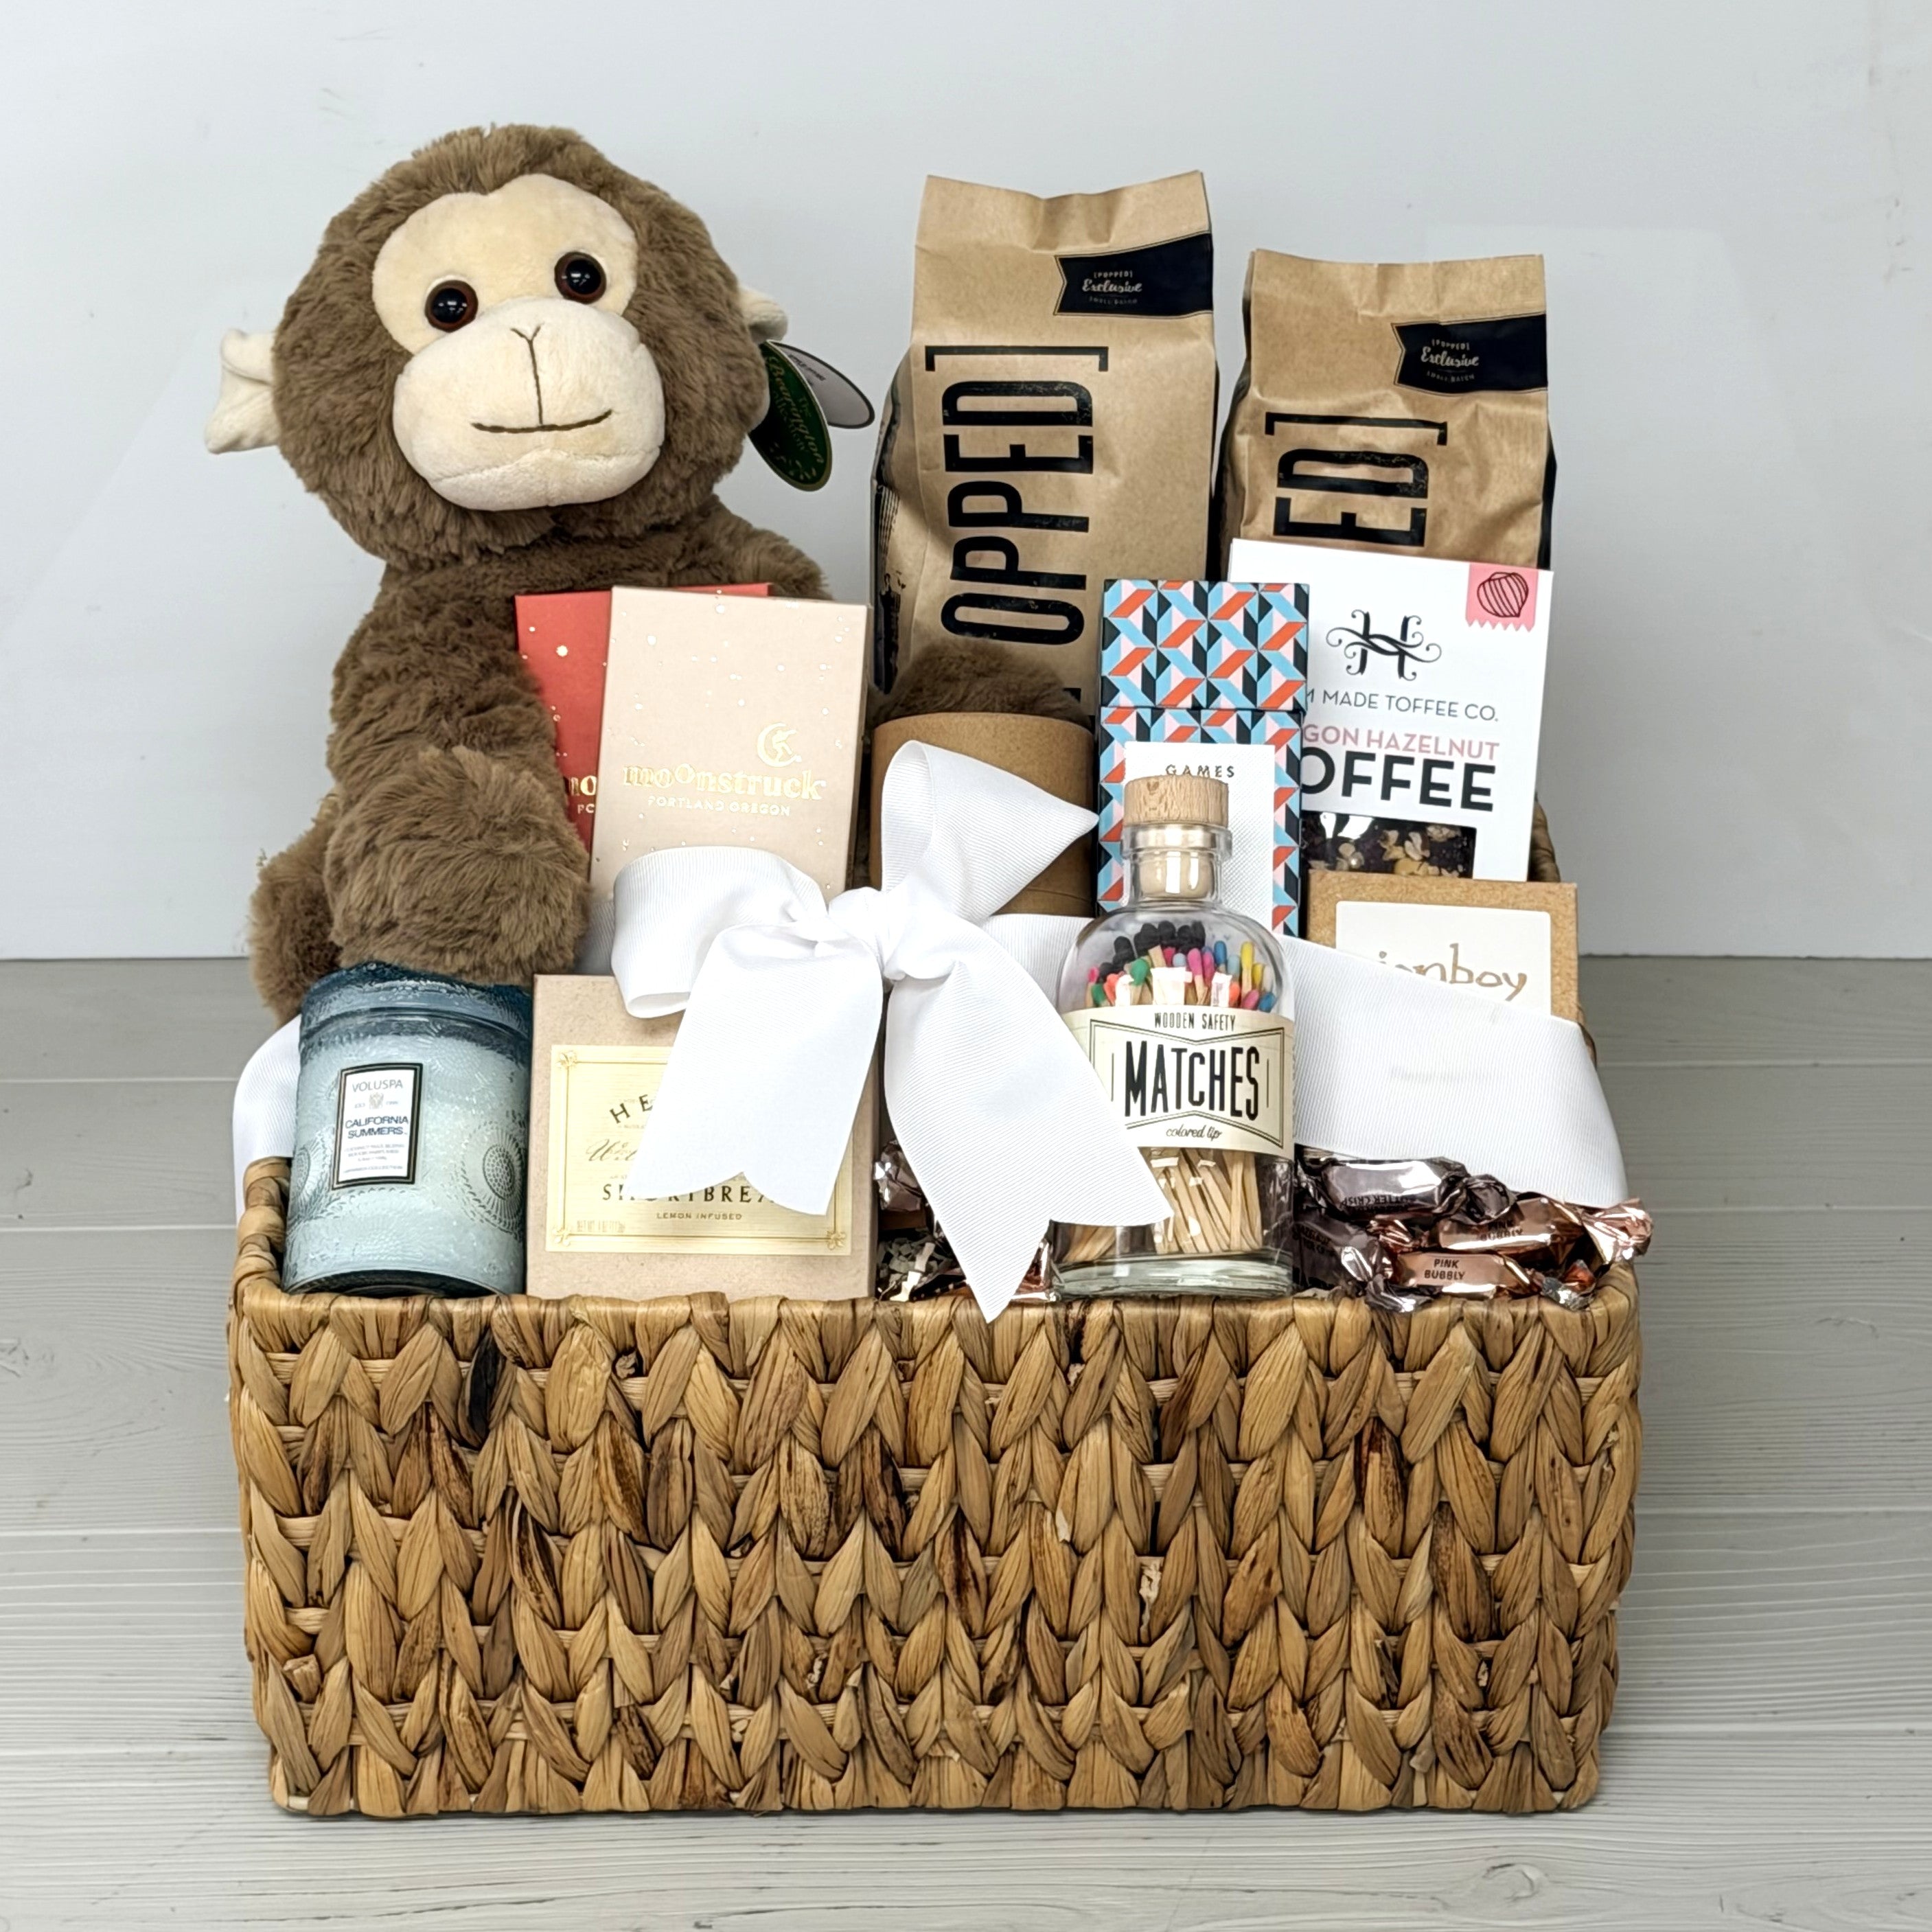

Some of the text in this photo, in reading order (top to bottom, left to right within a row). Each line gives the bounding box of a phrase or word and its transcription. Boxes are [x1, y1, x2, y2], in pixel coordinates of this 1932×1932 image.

[1082, 278, 1142, 293] Exclusive
[1421, 346, 1480, 367] Exclusive
[925, 345, 1108, 702] OPPED]
[1322, 689, 1379, 709] MADE
[1385, 695, 1459, 717] TOFFEE
[1464, 704, 1499, 722] CO.
[1366, 728, 1500, 761] HAZELNUT
[1165, 764, 1235, 779] GAMES
[647, 796, 792, 817] PORTLAND OREGON
[1154, 1012, 1236, 1031] WOODEN SAFETY
[352, 1079, 404, 1092] VOLUSPA
[1125, 1040, 1260, 1121] MATCHES
[345, 1116, 409, 1129] CALIFORNIA
[347, 1127, 404, 1140] SUMMERS
[1165, 1124, 1223, 1141] colored tip
[656, 1212, 743, 1221] LEMON INFUSED
[1434, 1258, 1460, 1269] PINK
[1424, 1269, 1466, 1280] BUBBLY
